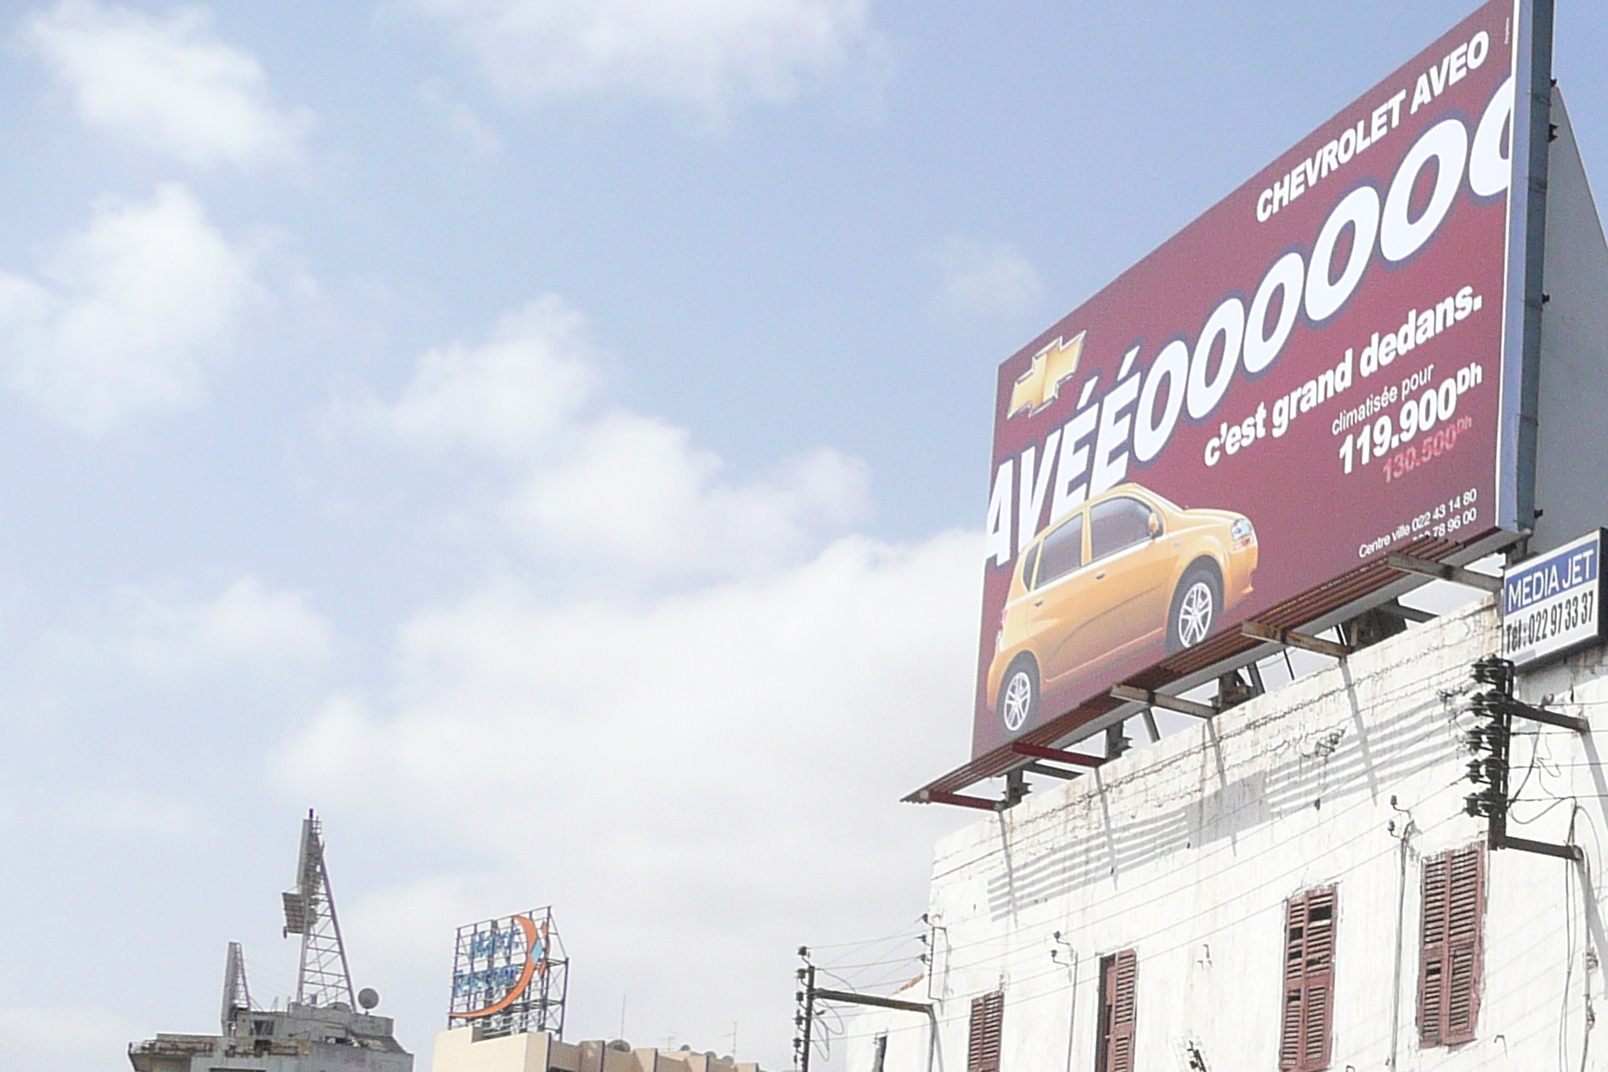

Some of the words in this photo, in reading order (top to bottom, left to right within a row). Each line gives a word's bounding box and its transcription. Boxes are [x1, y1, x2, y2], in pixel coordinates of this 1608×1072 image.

[1257, 89, 1406, 223] CHEVROLET
[1409, 31, 1489, 115] AVEO
[1204, 402, 1266, 467] c'est
[1272, 348, 1353, 438] grand
[1360, 285, 1482, 377] dedans.
[1332, 386, 1398, 435] climatisée
[1401, 364, 1434, 401] pour
[1359, 534, 1391, 558] Centre
[1391, 524, 1411, 542] ville
[1412, 511, 1431, 531] 022
[1433, 504, 1446, 520] 43
[1448, 496, 1461, 513] 14
[1447, 515, 1461, 533] 96
[1463, 507, 1477, 525] 00
[1508, 564, 1559, 612] MEDIA
[1562, 549, 1594, 589] JET
[1528, 609, 1548, 645] 022
[1550, 601, 1563, 638] 97
[1564, 595, 1579, 631] 33
[1581, 589, 1594, 625] 37
